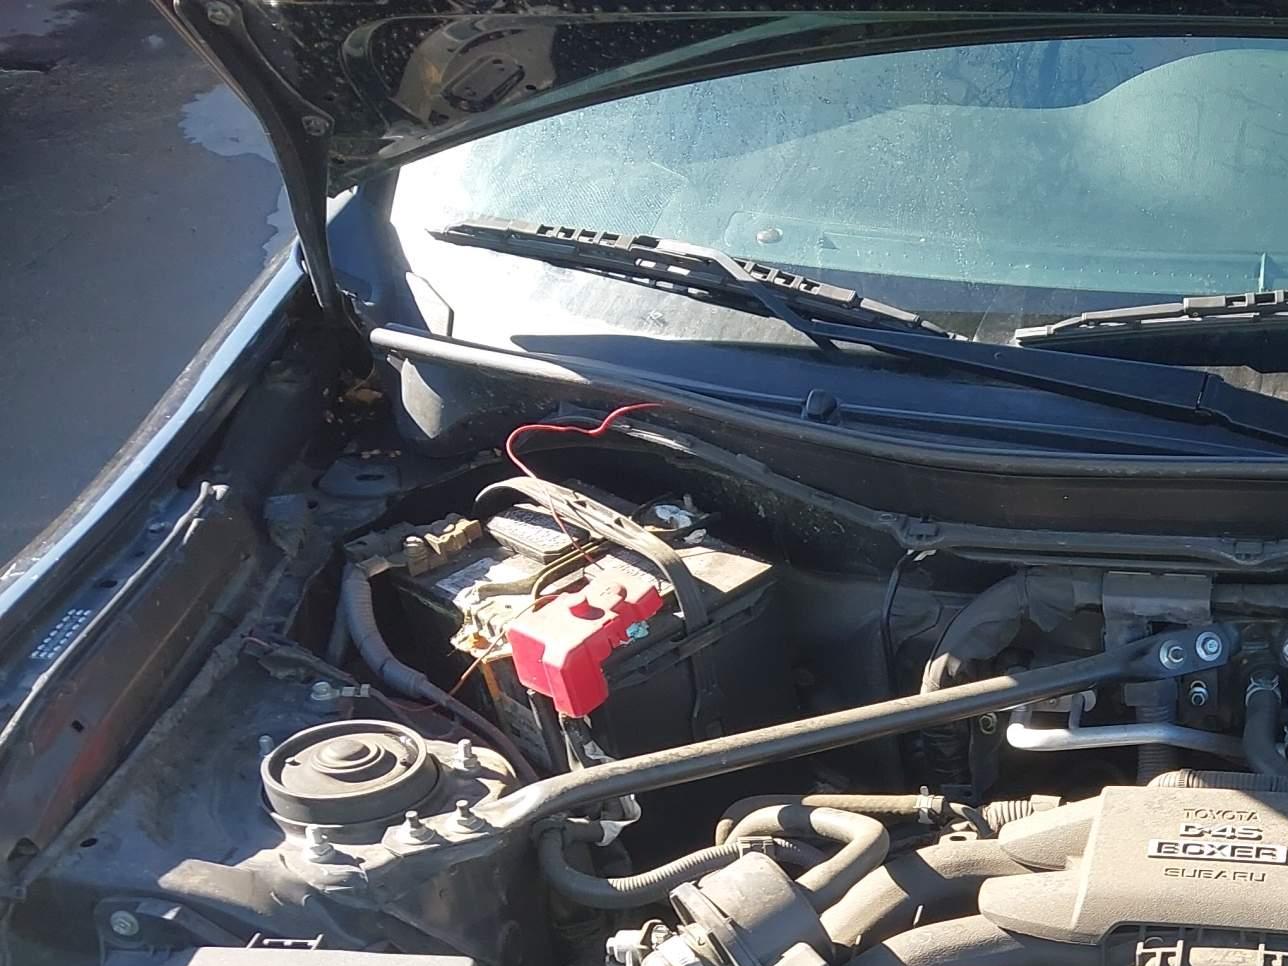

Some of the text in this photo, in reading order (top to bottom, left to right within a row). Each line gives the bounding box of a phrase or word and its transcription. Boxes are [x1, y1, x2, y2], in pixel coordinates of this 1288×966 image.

[1183, 808, 1260, 822] TOYOTA
[1157, 841, 1278, 860] BOXER
[1164, 867, 1267, 883] SUBARU
